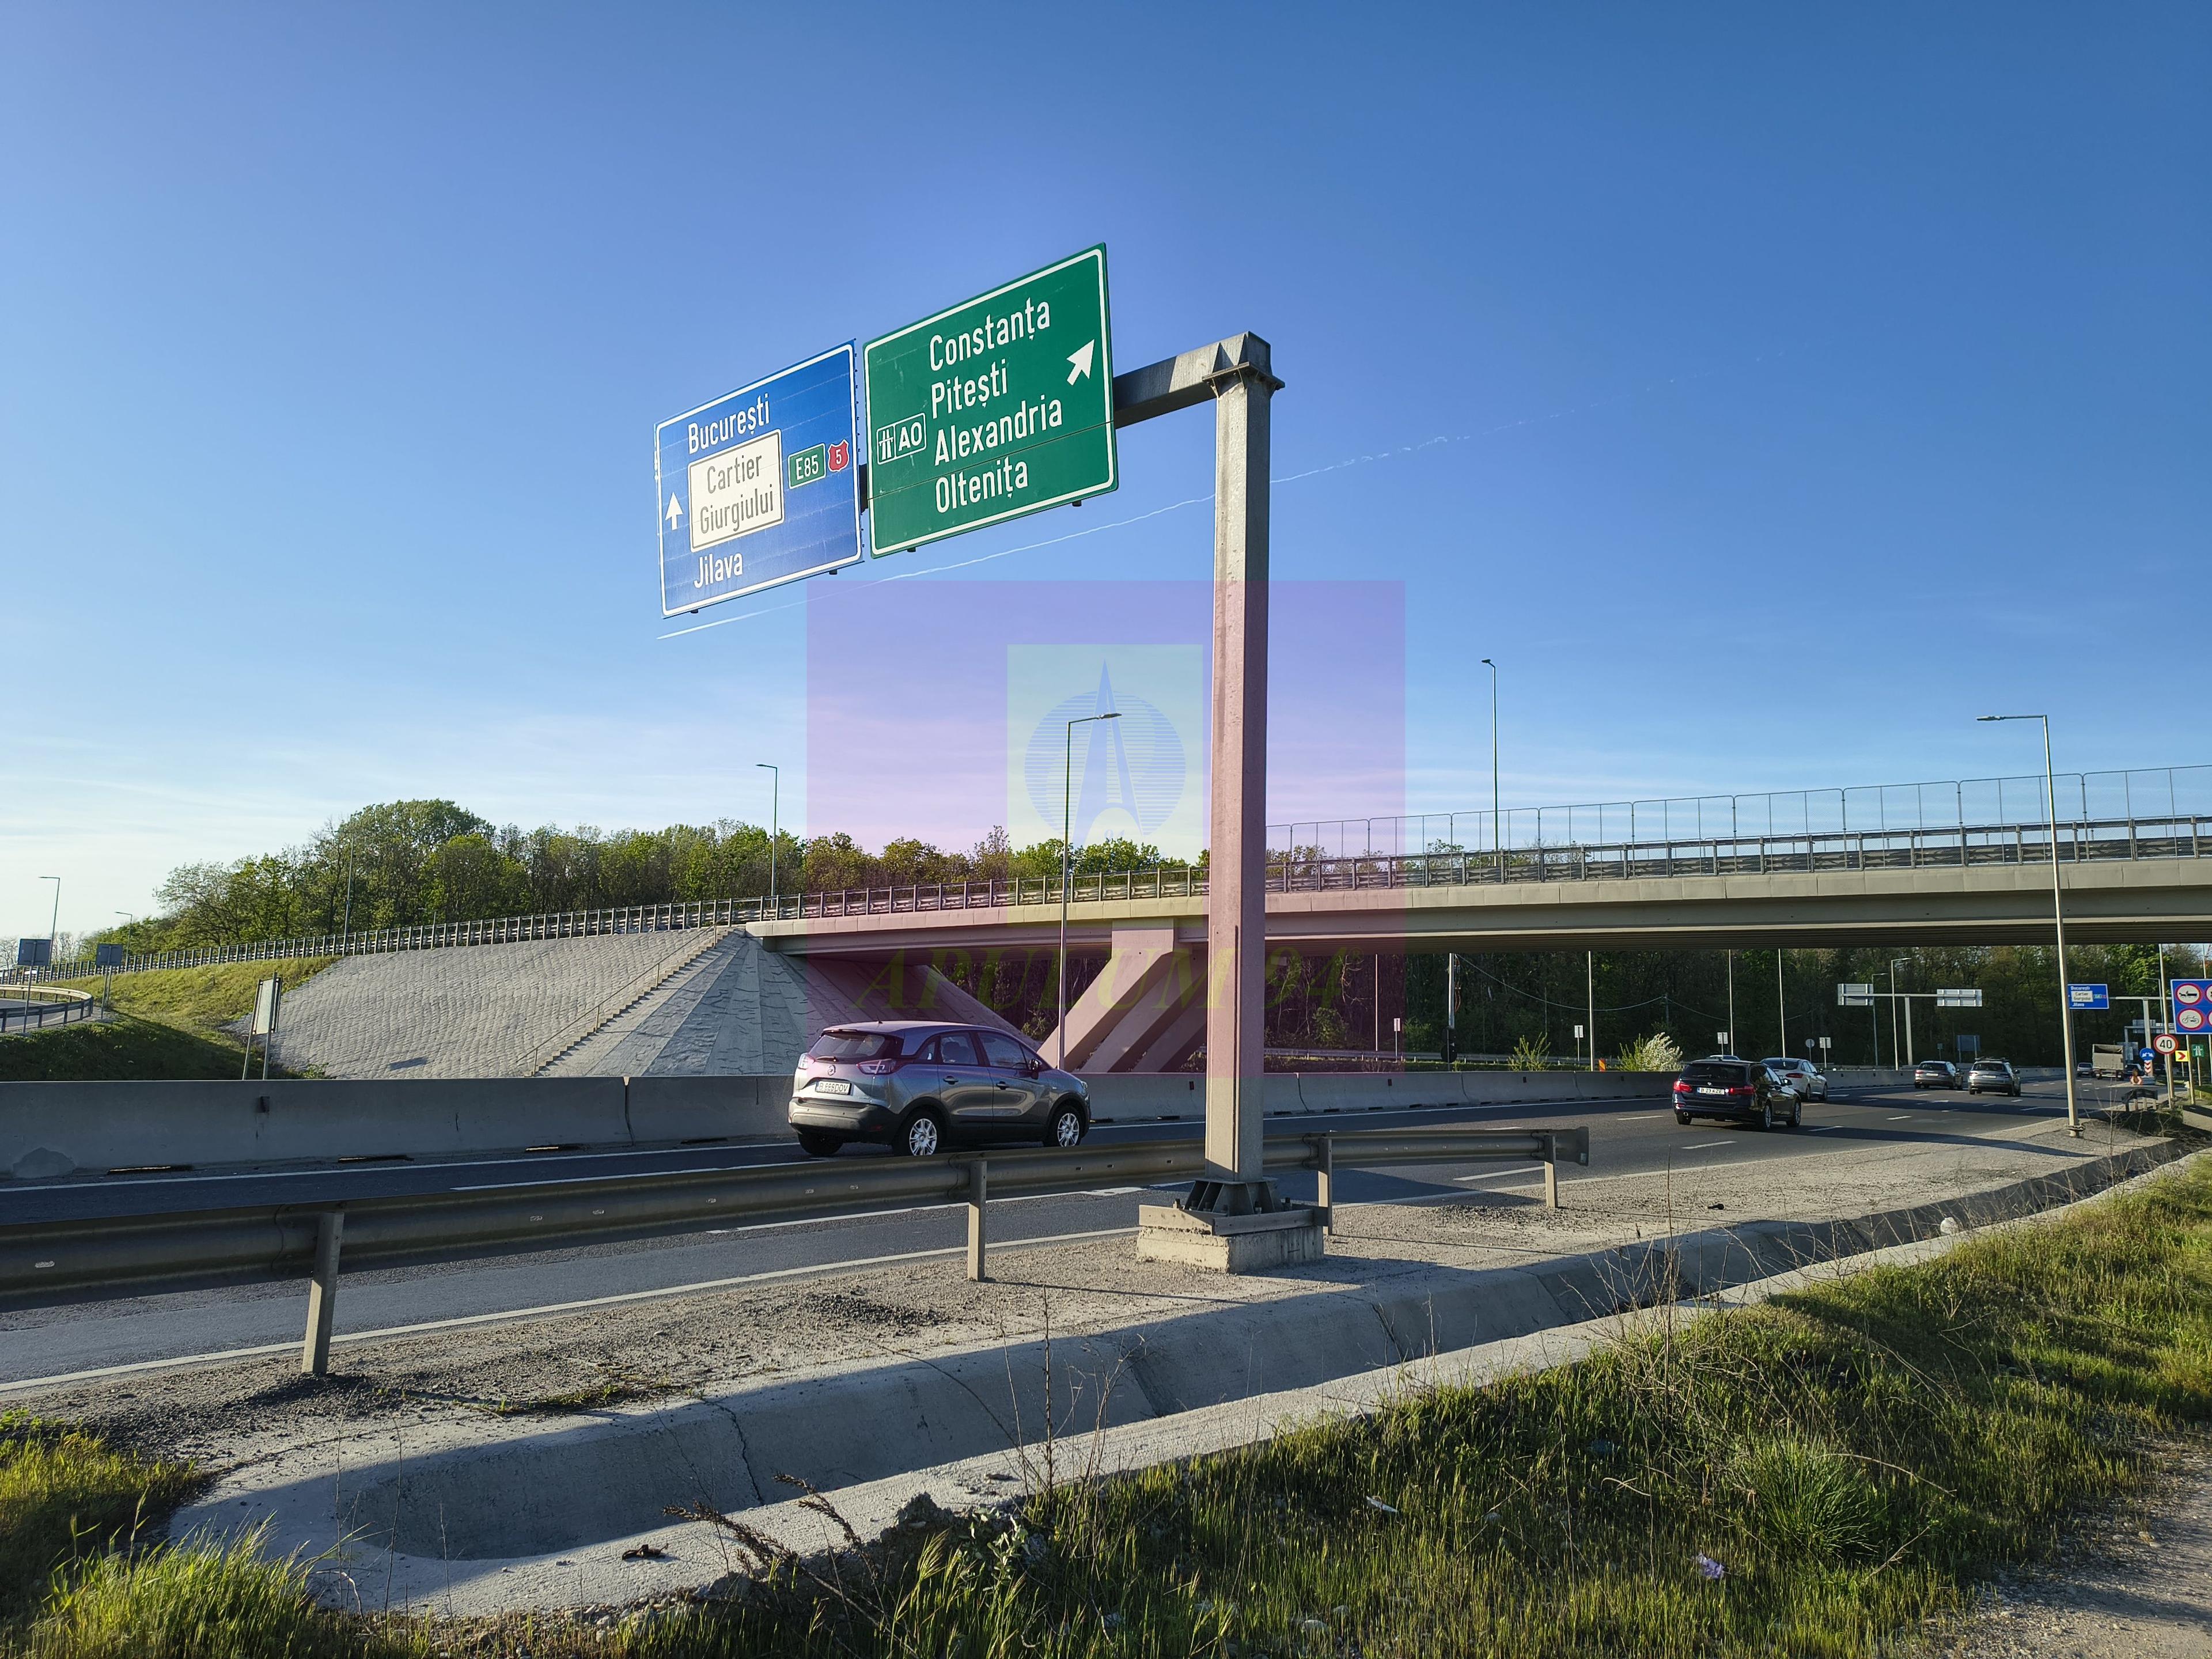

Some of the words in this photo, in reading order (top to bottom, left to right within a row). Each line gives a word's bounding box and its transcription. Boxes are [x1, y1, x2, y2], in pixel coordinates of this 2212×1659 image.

[929, 297, 1051, 372] Constanța
[931, 358, 1007, 419] Pitești
[688, 393, 770, 454] București
[934, 394, 1063, 466] Alexandria
[707, 454, 763, 494] Cartier
[796, 454, 819, 480] E85
[835, 449, 842, 464] 5
[700, 484, 774, 534] Giurgiului
[935, 457, 1028, 514] Oltenița
[694, 552, 744, 589] Jilava
[2160, 1039, 2172, 1049] 40
